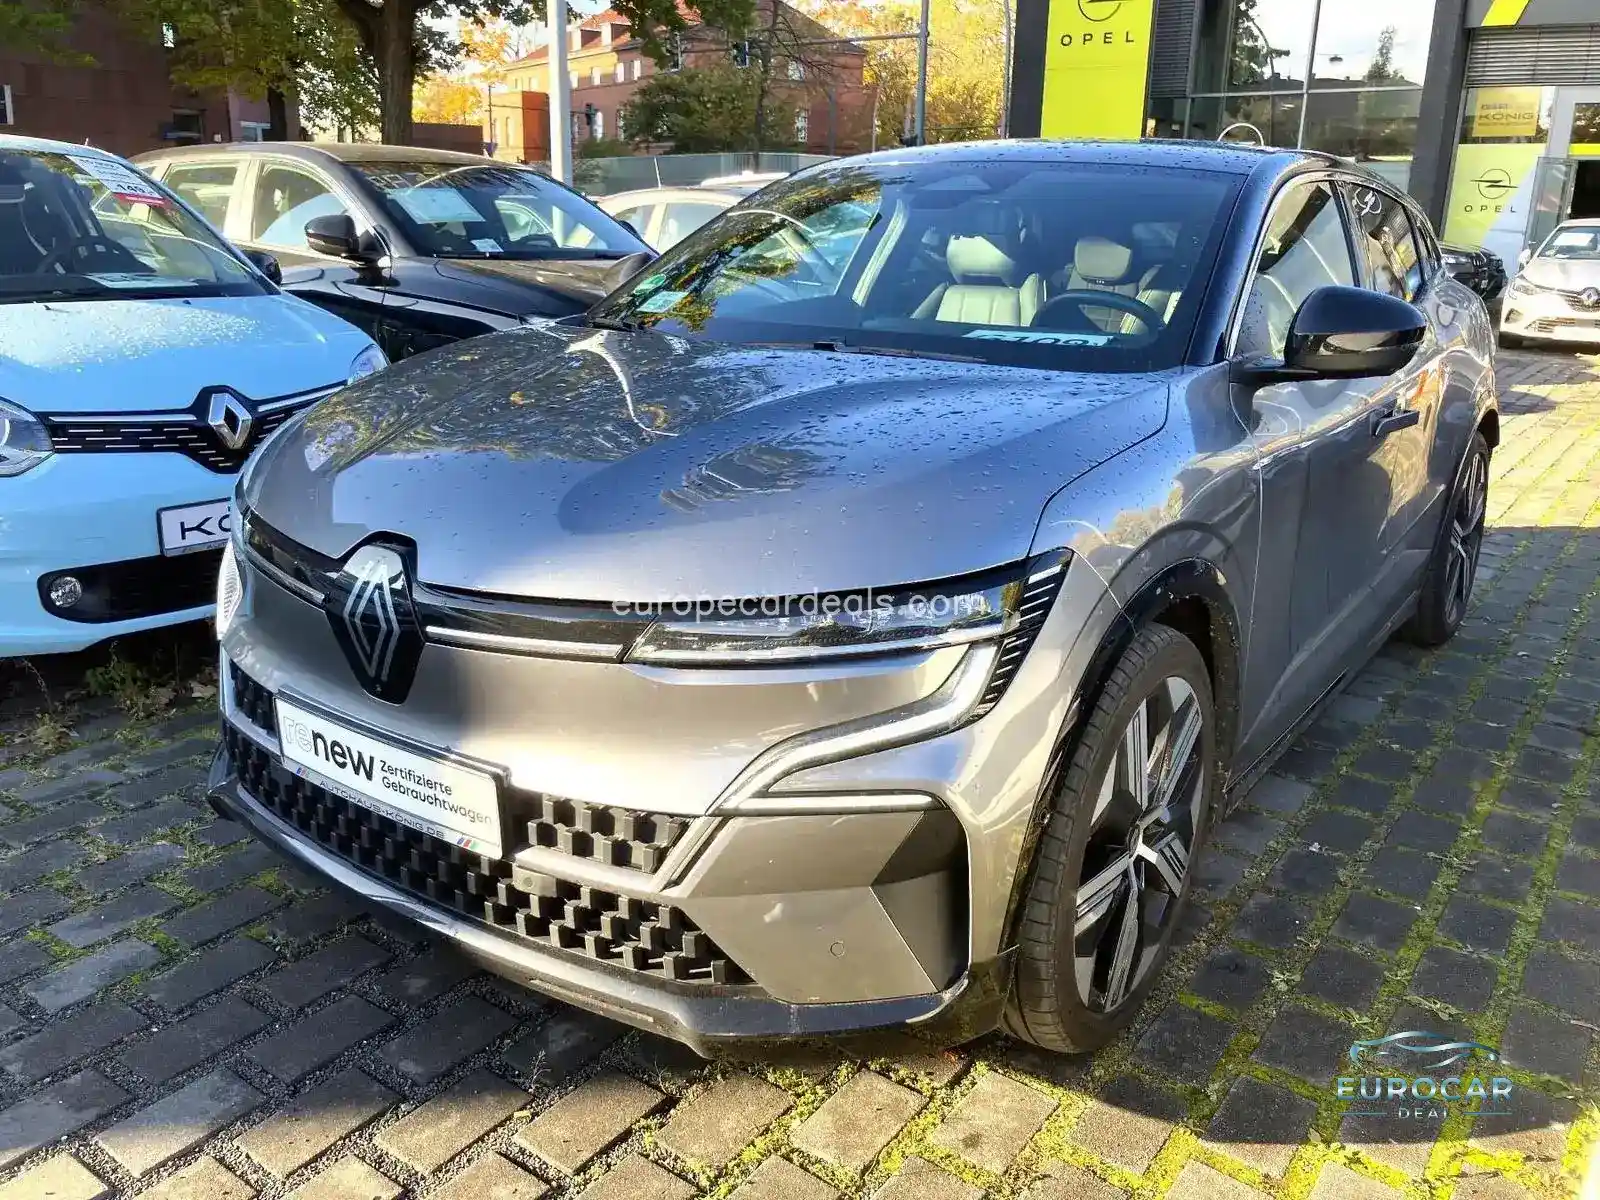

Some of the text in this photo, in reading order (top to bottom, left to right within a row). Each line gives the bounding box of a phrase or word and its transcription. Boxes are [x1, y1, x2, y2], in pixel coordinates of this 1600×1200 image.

[1060, 31, 1134, 47] OPEL
[380, 759, 453, 796] Zertifizierte
[382, 777, 493, 826] Gebrauchtwagen
